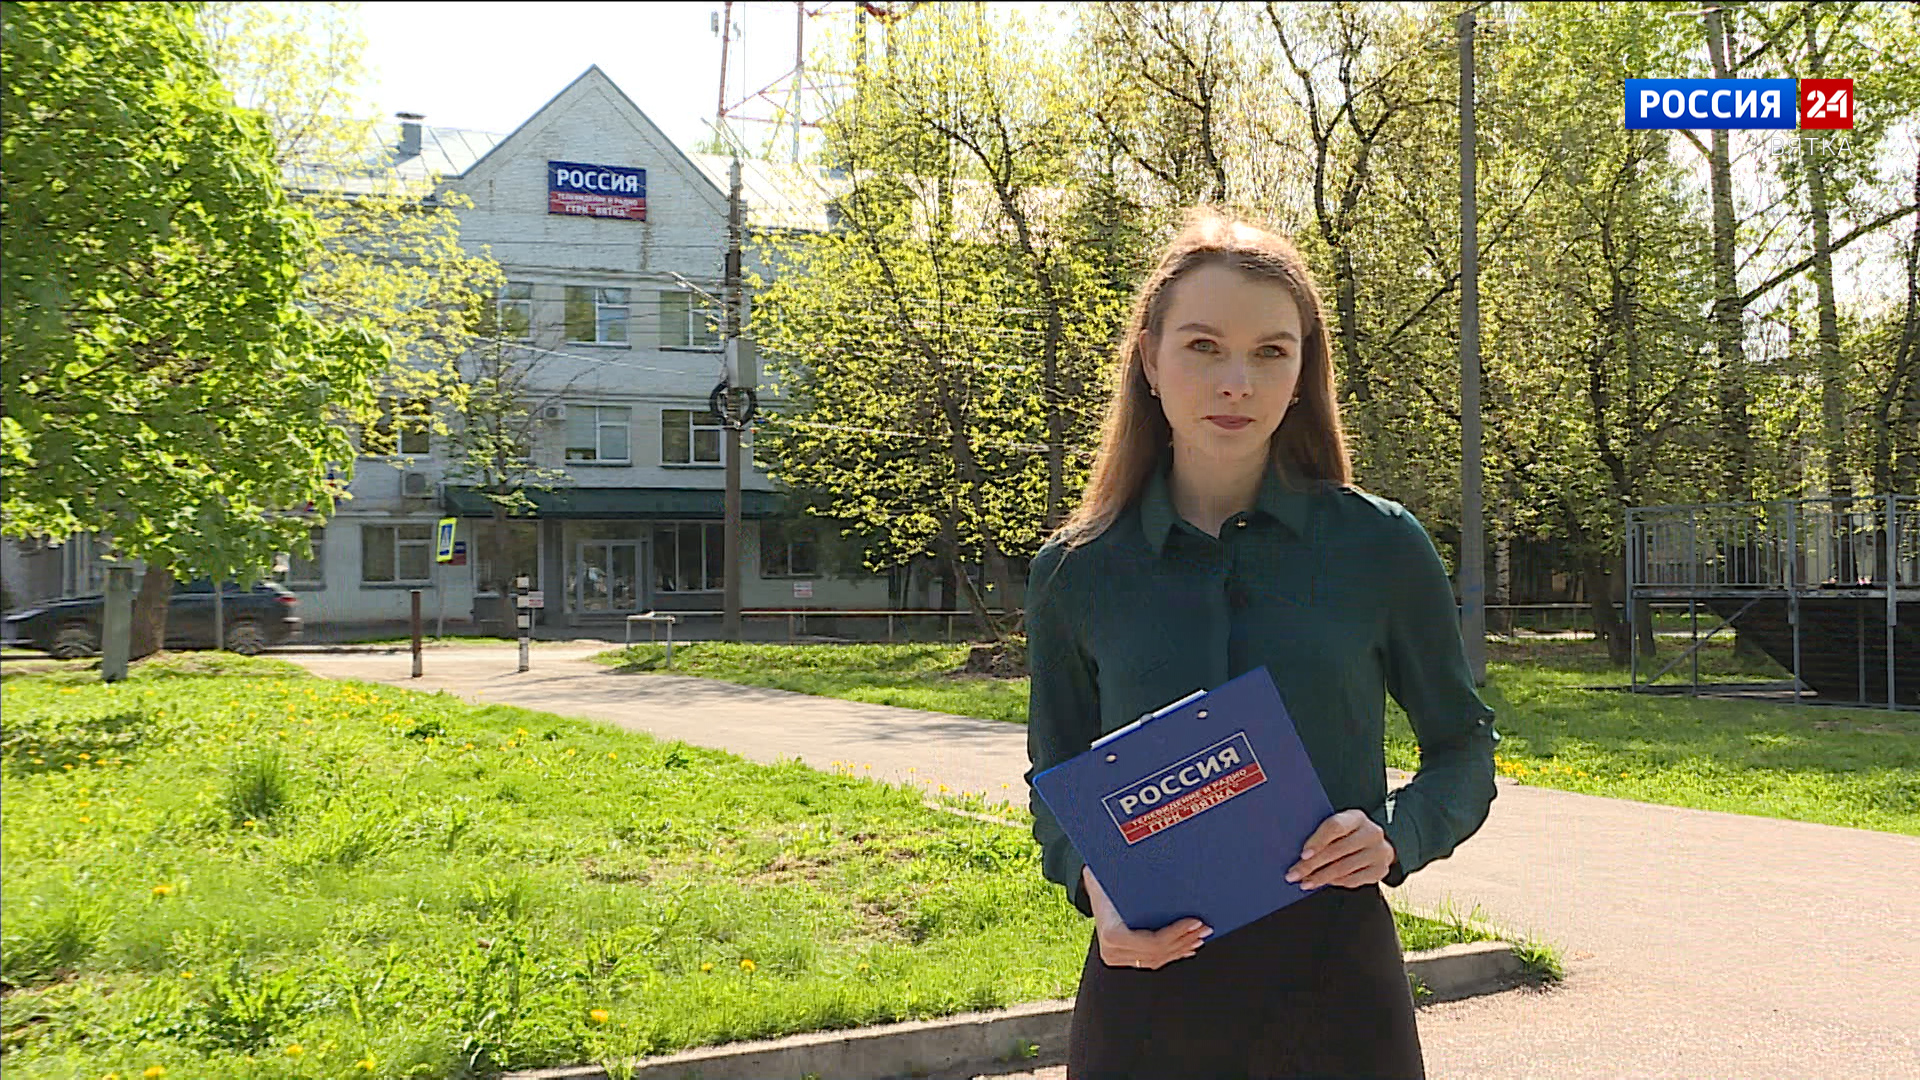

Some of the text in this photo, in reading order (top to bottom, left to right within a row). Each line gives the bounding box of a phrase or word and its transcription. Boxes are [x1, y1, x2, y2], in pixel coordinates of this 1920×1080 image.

[557, 168, 638, 193] РОССИЯ
[565, 204, 589, 214] ГТРК
[1118, 746, 1241, 815] РОССИЯ
[1212, 768, 1248, 791] РАДИО
[1148, 814, 1181, 834] ГТРК
